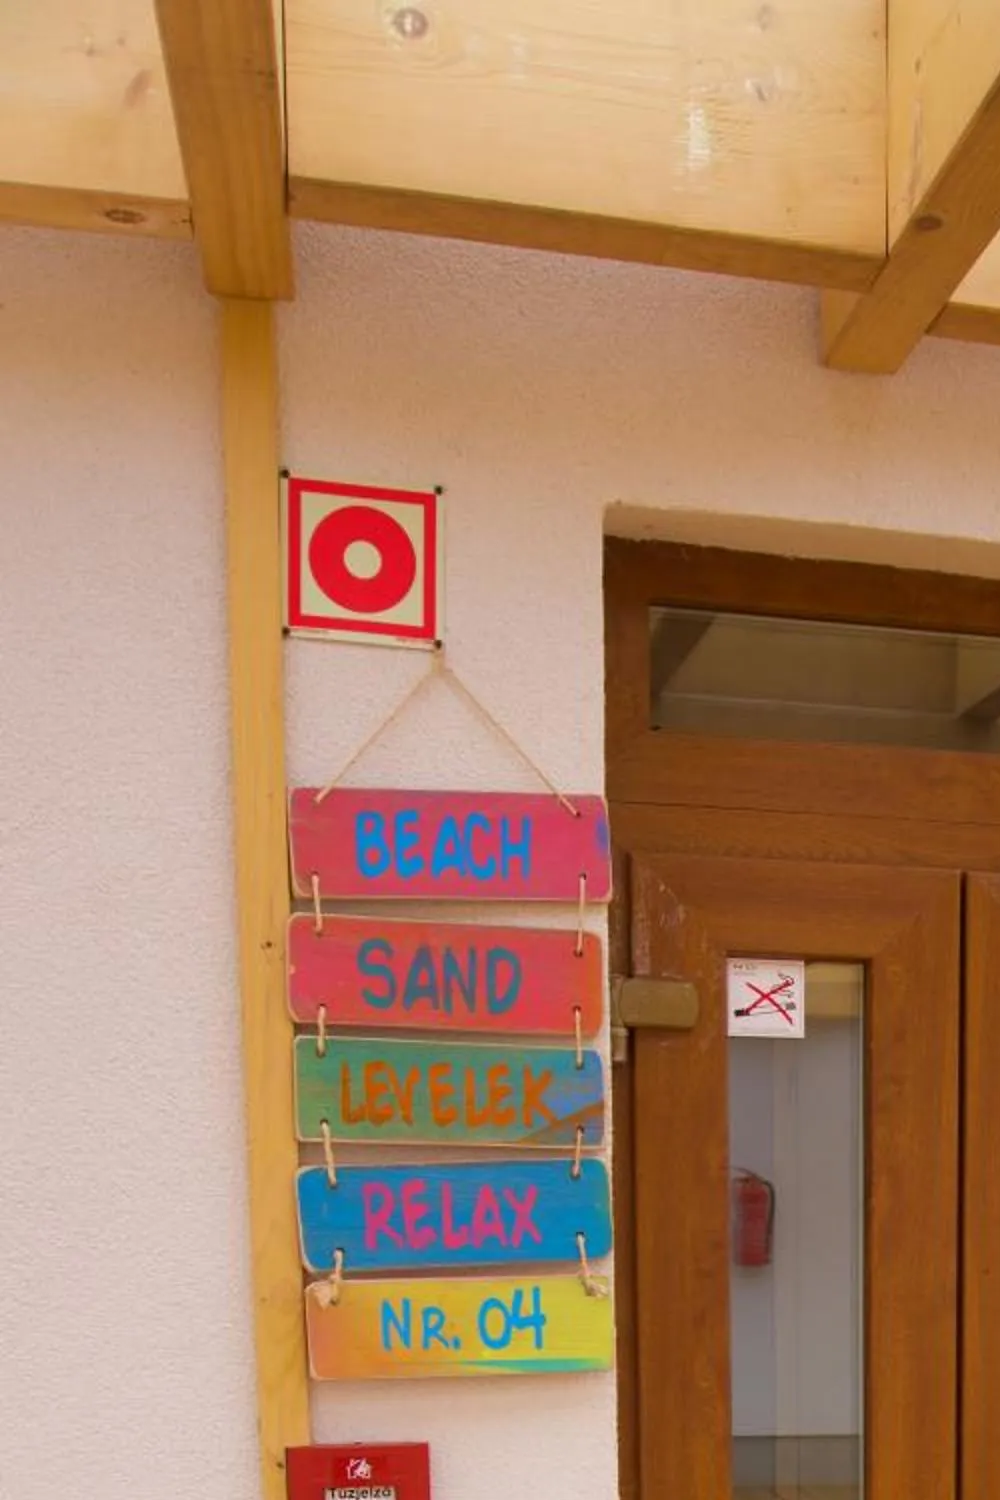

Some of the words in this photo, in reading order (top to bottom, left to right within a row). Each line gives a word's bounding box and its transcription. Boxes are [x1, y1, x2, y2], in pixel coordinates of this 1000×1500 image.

[354, 808, 533, 881] BEACH
[356, 937, 523, 1016] SAND
[361, 1177, 543, 1250] RELAX
[477, 1286, 547, 1351] 04
